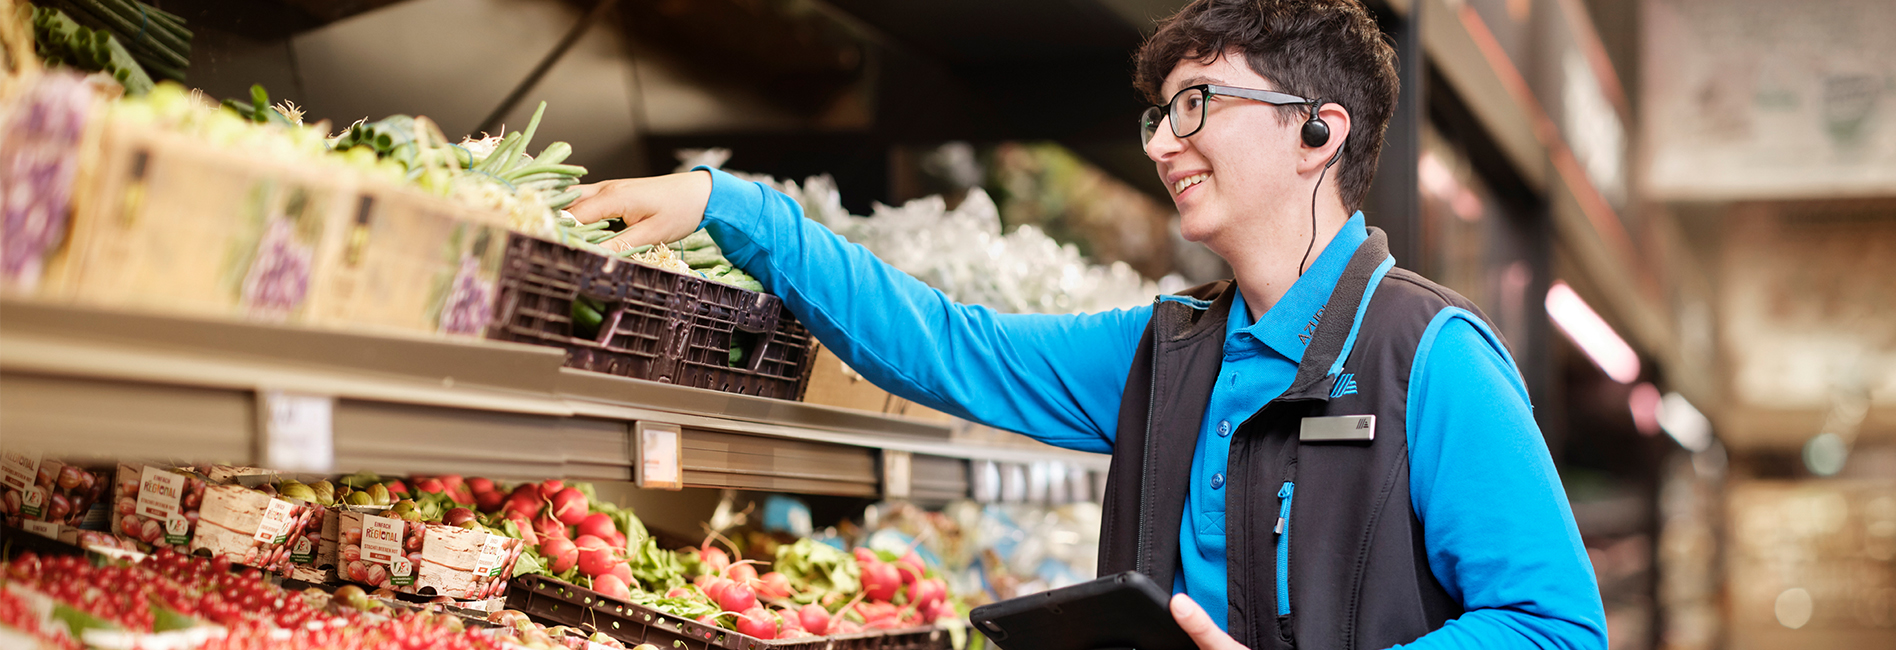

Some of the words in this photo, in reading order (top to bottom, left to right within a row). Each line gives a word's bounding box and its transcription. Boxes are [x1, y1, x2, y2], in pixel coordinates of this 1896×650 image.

[153, 474, 171, 484] EINFACH
[33, 524, 47, 532] EINFACH
[374, 521, 391, 530] EINFACH
